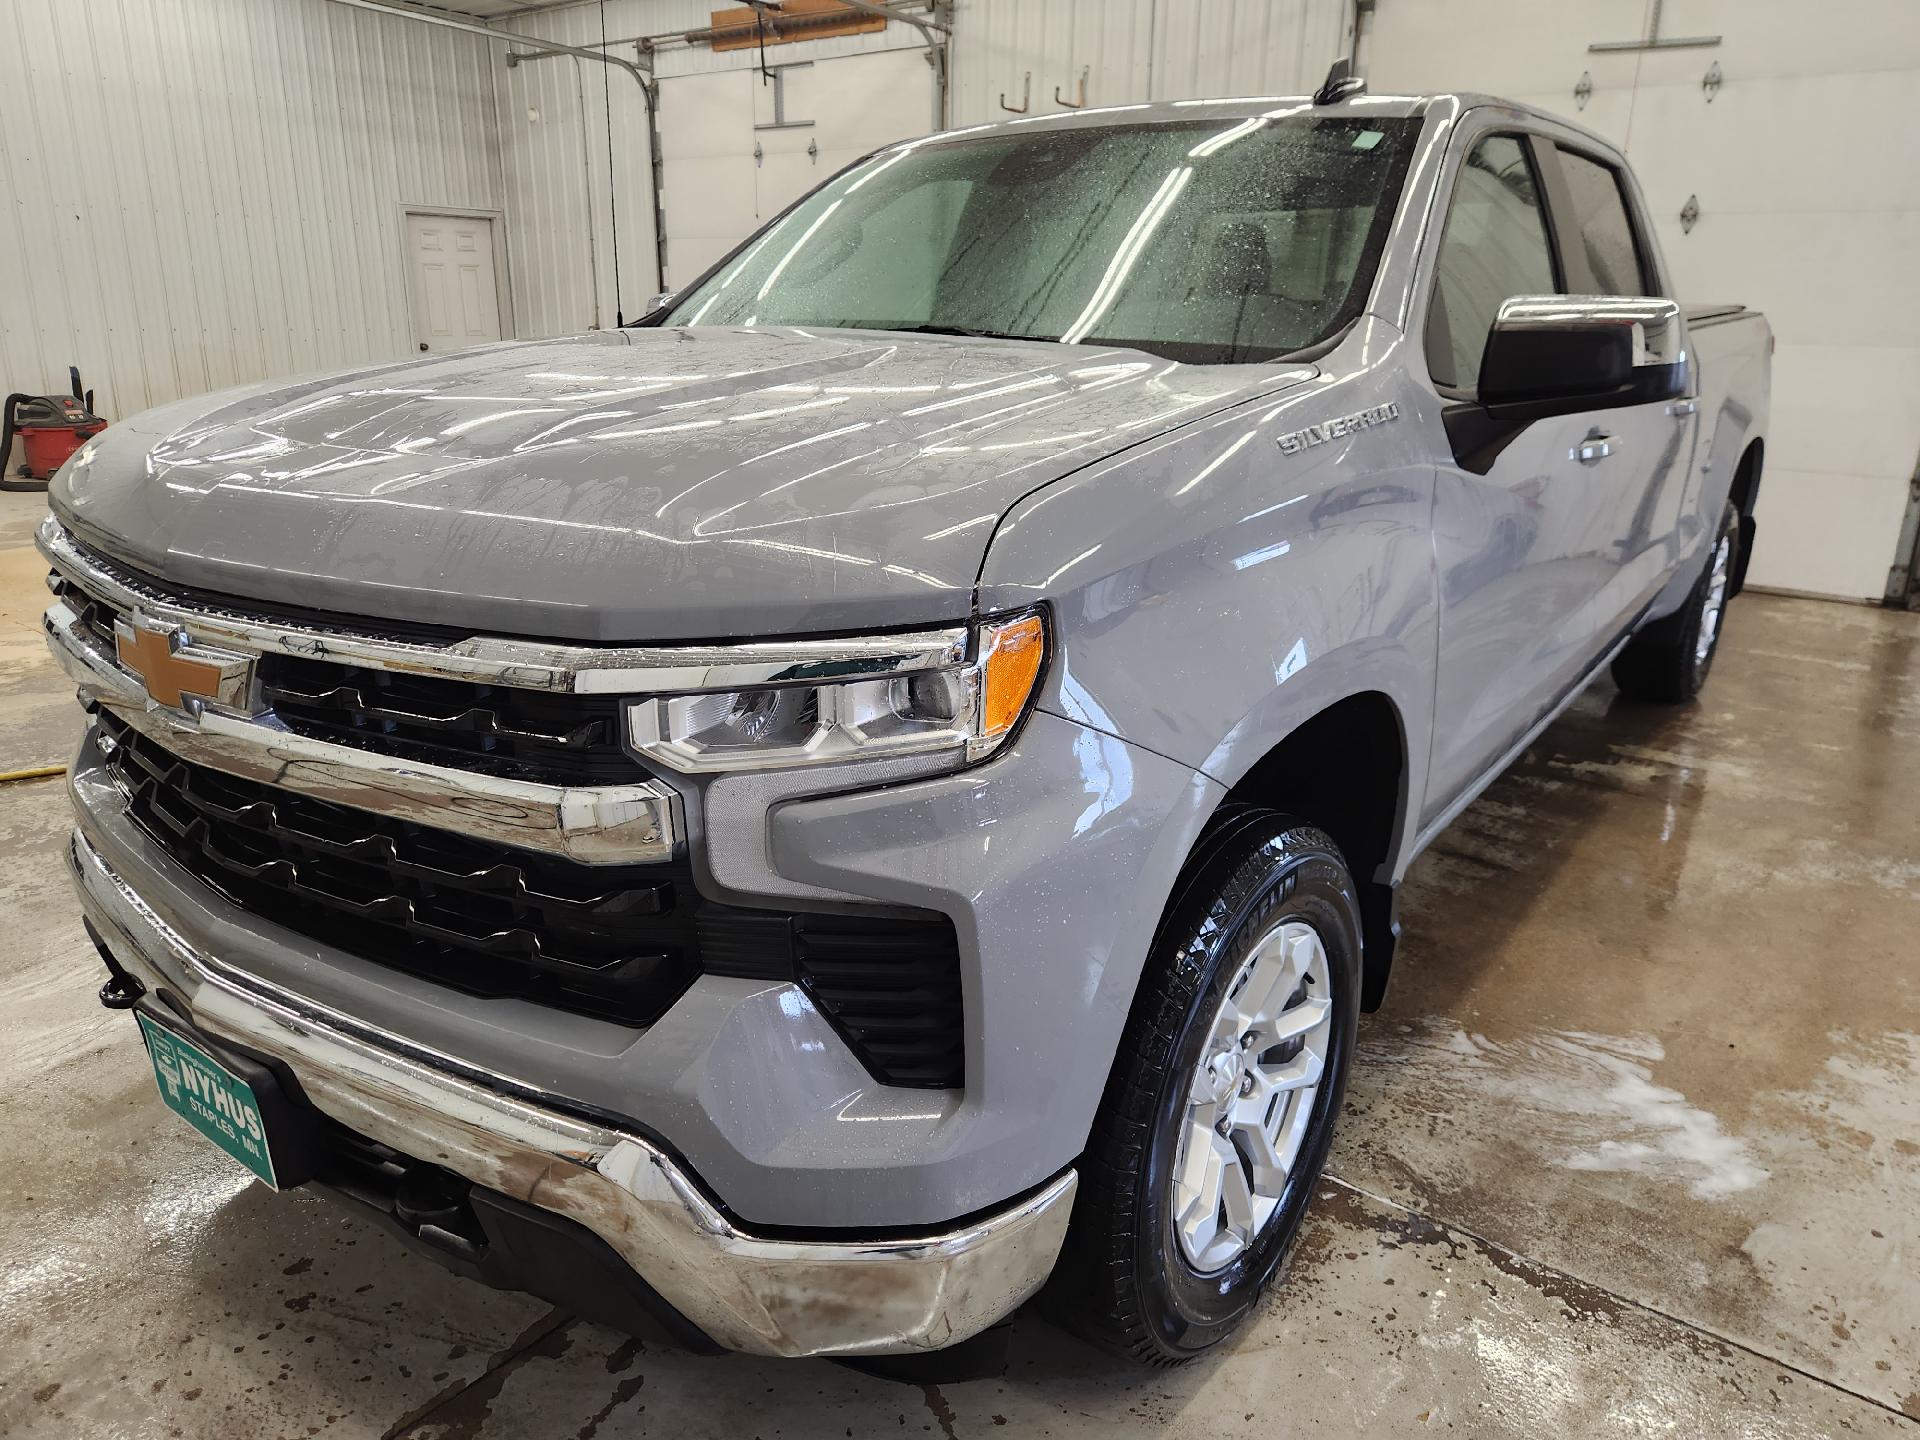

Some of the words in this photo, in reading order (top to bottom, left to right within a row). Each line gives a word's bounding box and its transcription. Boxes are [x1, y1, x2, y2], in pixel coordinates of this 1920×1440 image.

[1276, 401, 1399, 456] SILVERADO
[179, 1058, 262, 1141] NYHUS
[190, 1096, 239, 1144] STAPLES,
